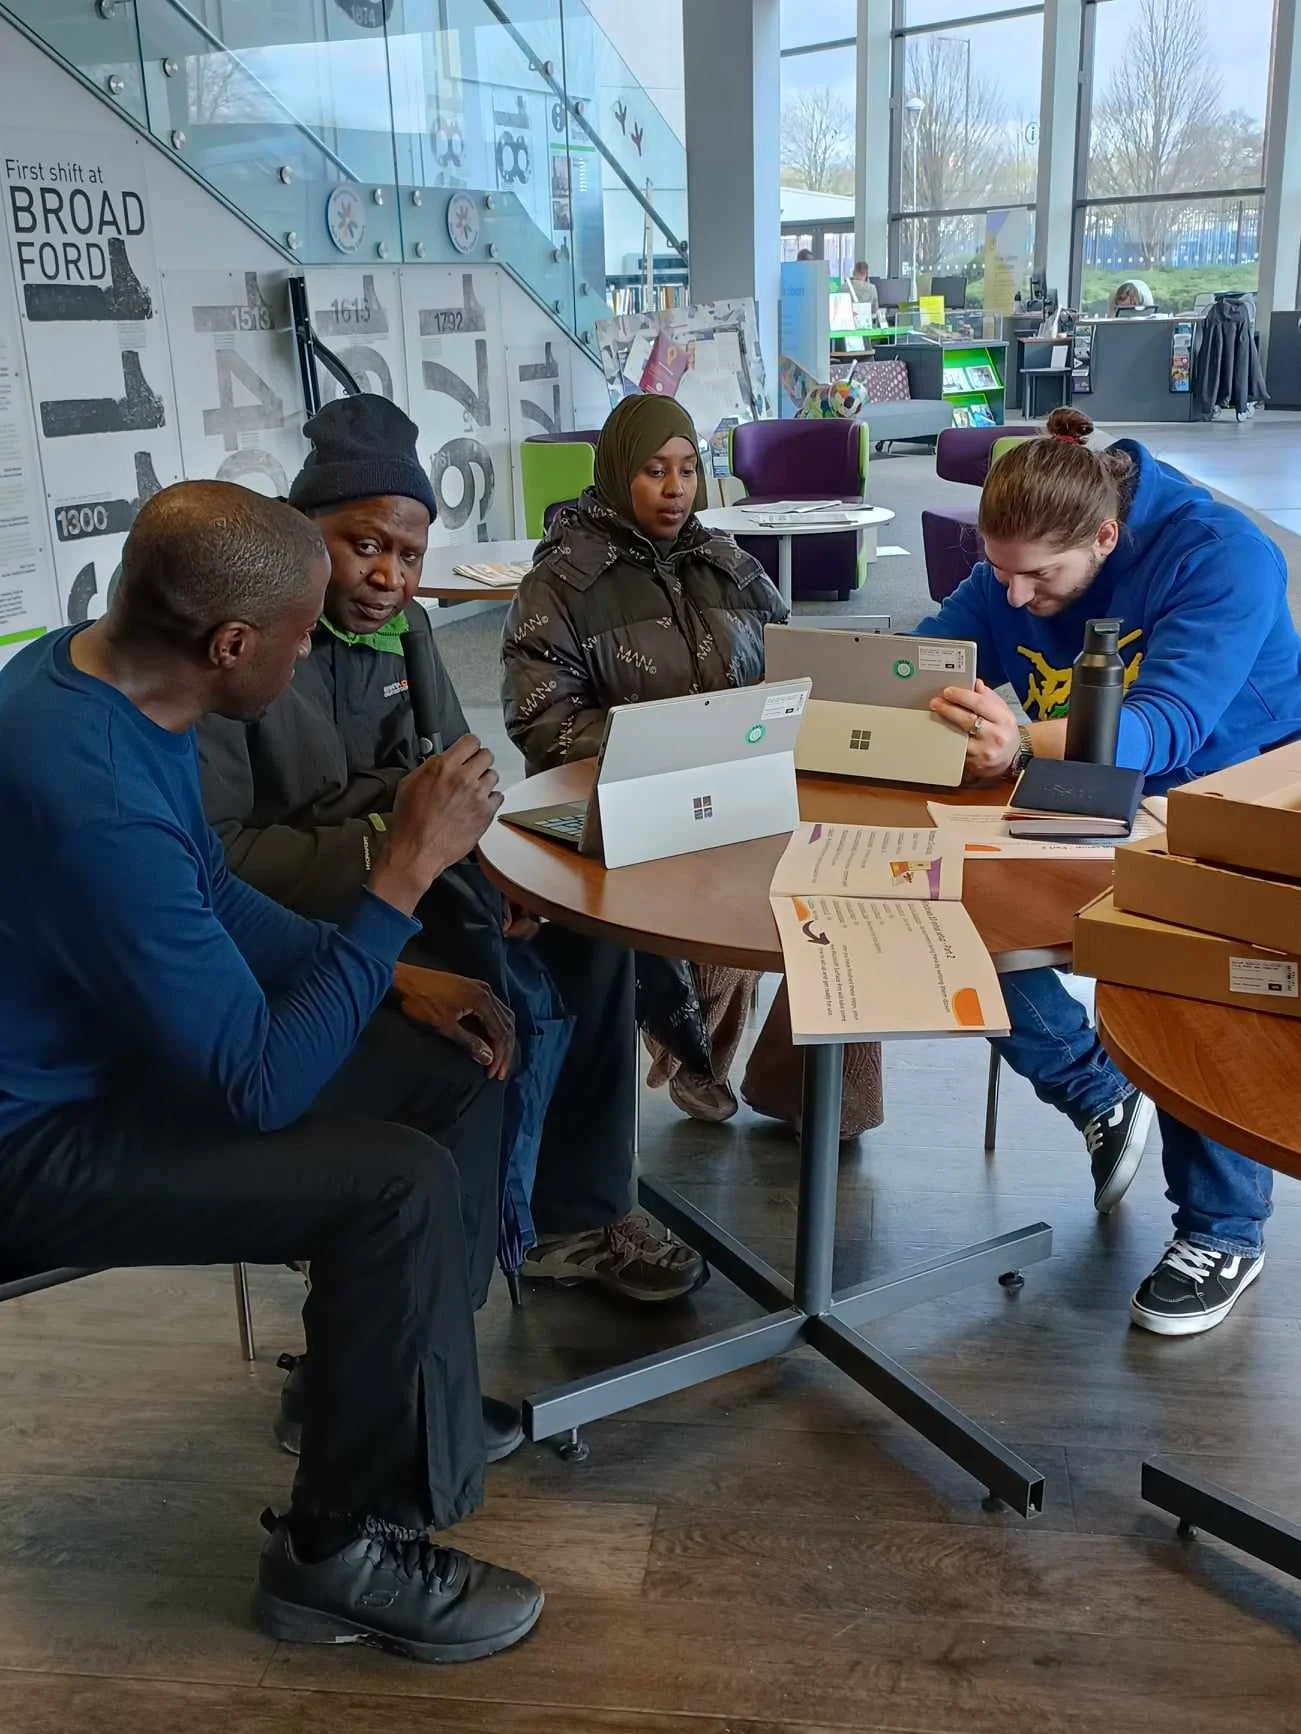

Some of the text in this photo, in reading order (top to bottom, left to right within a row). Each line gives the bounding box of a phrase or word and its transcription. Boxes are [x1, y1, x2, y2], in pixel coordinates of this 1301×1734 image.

[5, 159, 103, 184] First shift at
[9, 186, 145, 236] BROAD
[17, 241, 107, 281] FORD
[231, 306, 271, 331] 1513
[433, 311, 464, 333] 1792
[57, 506, 109, 537] 1300
